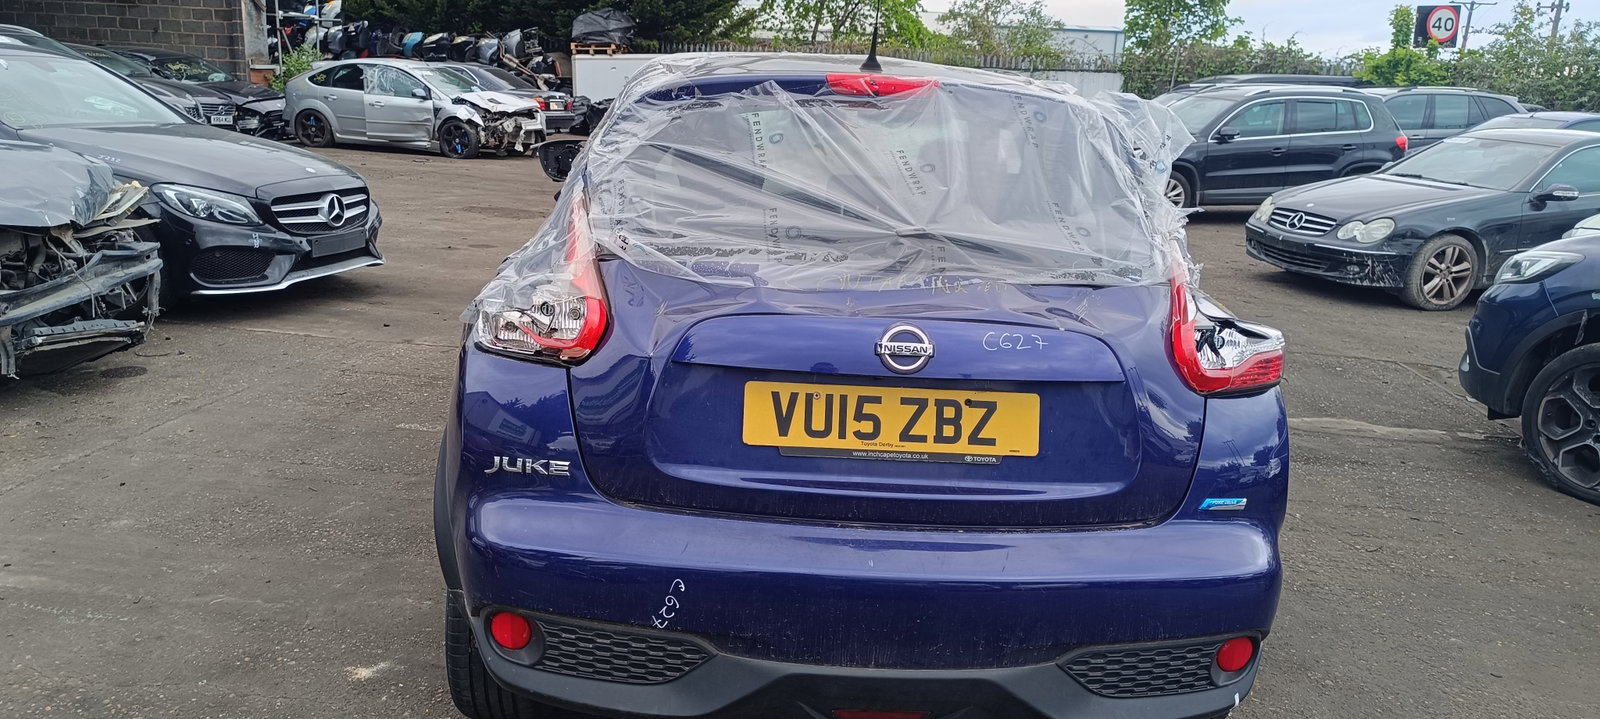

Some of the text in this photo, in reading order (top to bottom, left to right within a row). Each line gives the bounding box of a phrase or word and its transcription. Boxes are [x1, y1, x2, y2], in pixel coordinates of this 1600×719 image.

[1432, 17, 1454, 31] 40
[1014, 94, 1039, 149] ENDWRAP
[896, 149, 927, 195] FENDWRAP
[883, 344, 928, 353] NISSAN
[982, 331, 1049, 351] C627
[771, 391, 998, 446] VU15 ZBZ
[852, 450, 929, 460] www.inchcapetoyota.co.uk
[484, 455, 571, 476] JUKE
